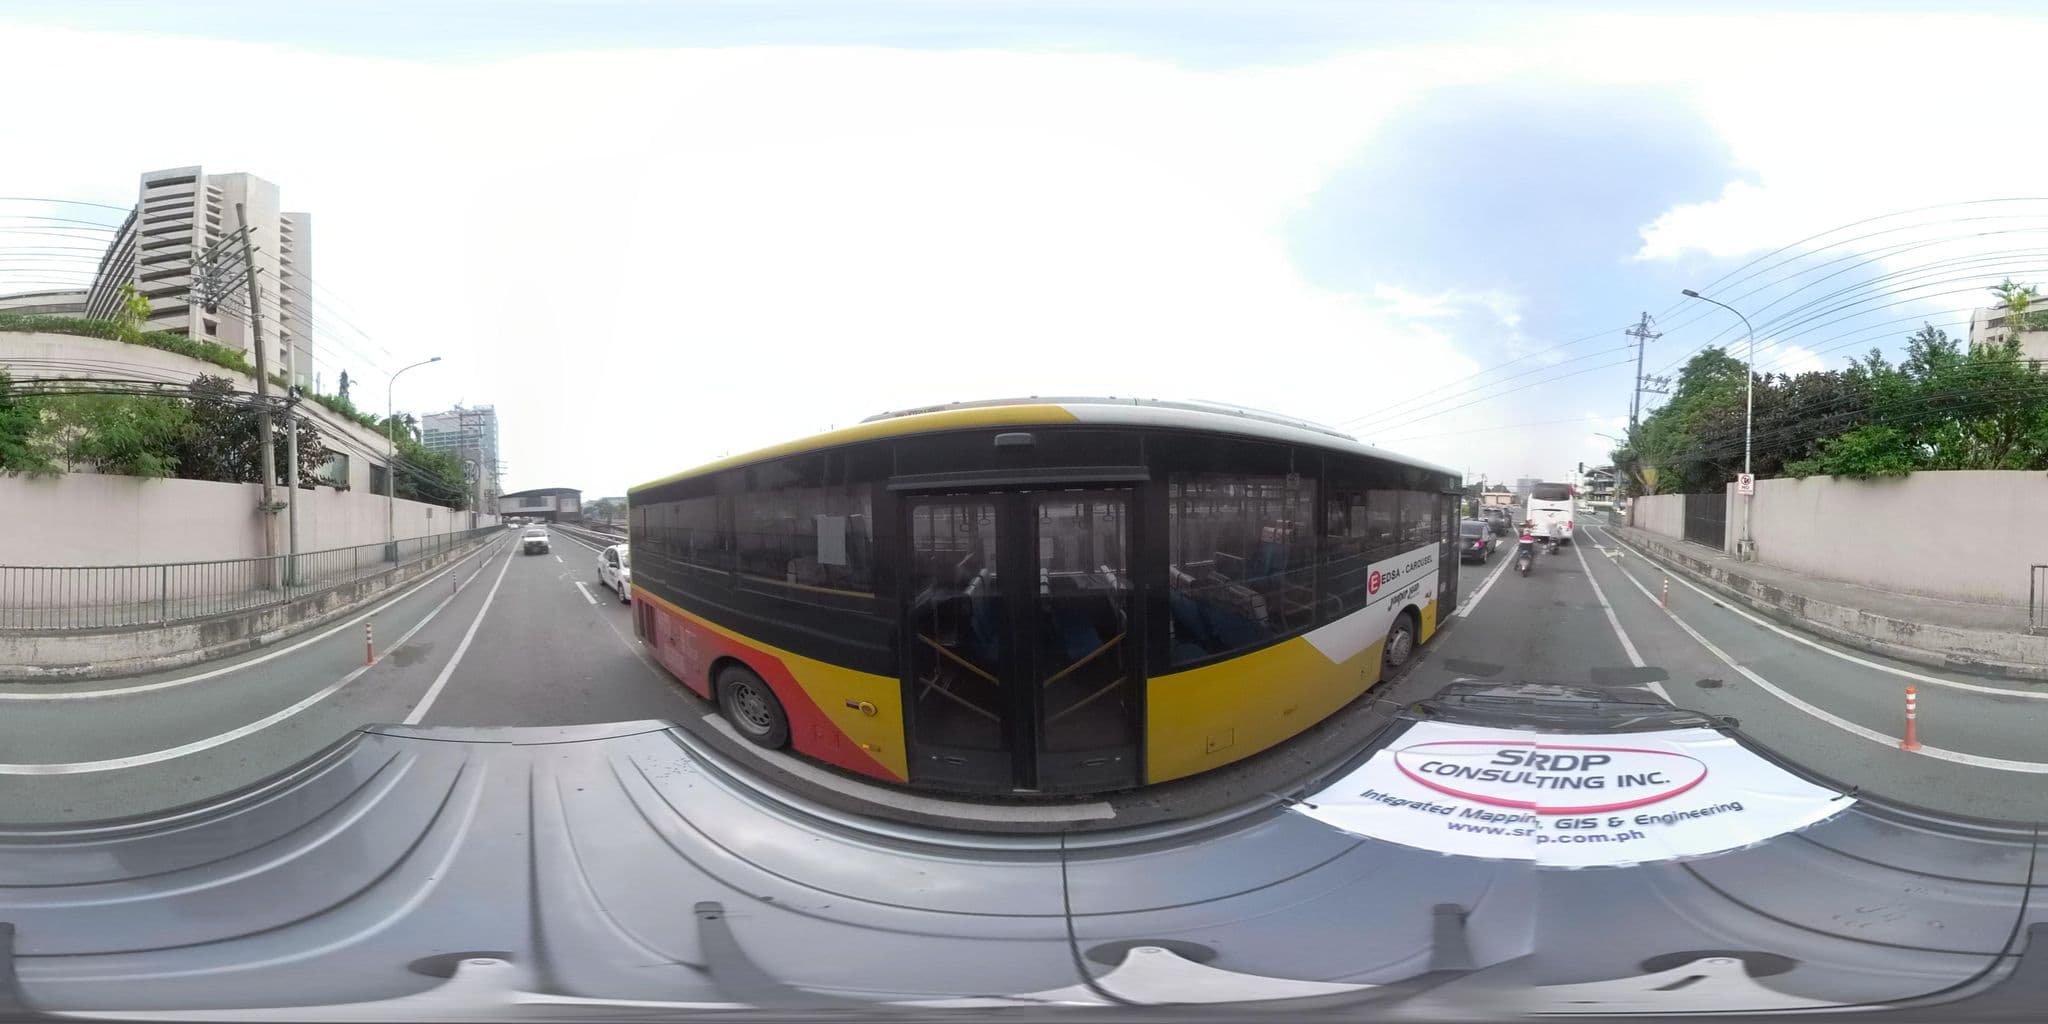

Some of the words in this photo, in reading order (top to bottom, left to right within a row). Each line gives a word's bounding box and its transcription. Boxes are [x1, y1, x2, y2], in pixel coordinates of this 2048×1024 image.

[1381, 568, 1400, 584] EDSA
[1405, 555, 1432, 573] CAROUSEL
[1490, 749, 1612, 772] SRDP
[1418, 761, 1606, 789] CONSULTING
[1617, 771, 1671, 789] INC.
[1359, 787, 1458, 816] Integrated
[1554, 817, 1599, 830] GIS
[1607, 816, 1626, 829] &
[1634, 800, 1744, 827] Engineering
[1448, 821, 1646, 845] www.srp.com.ph
